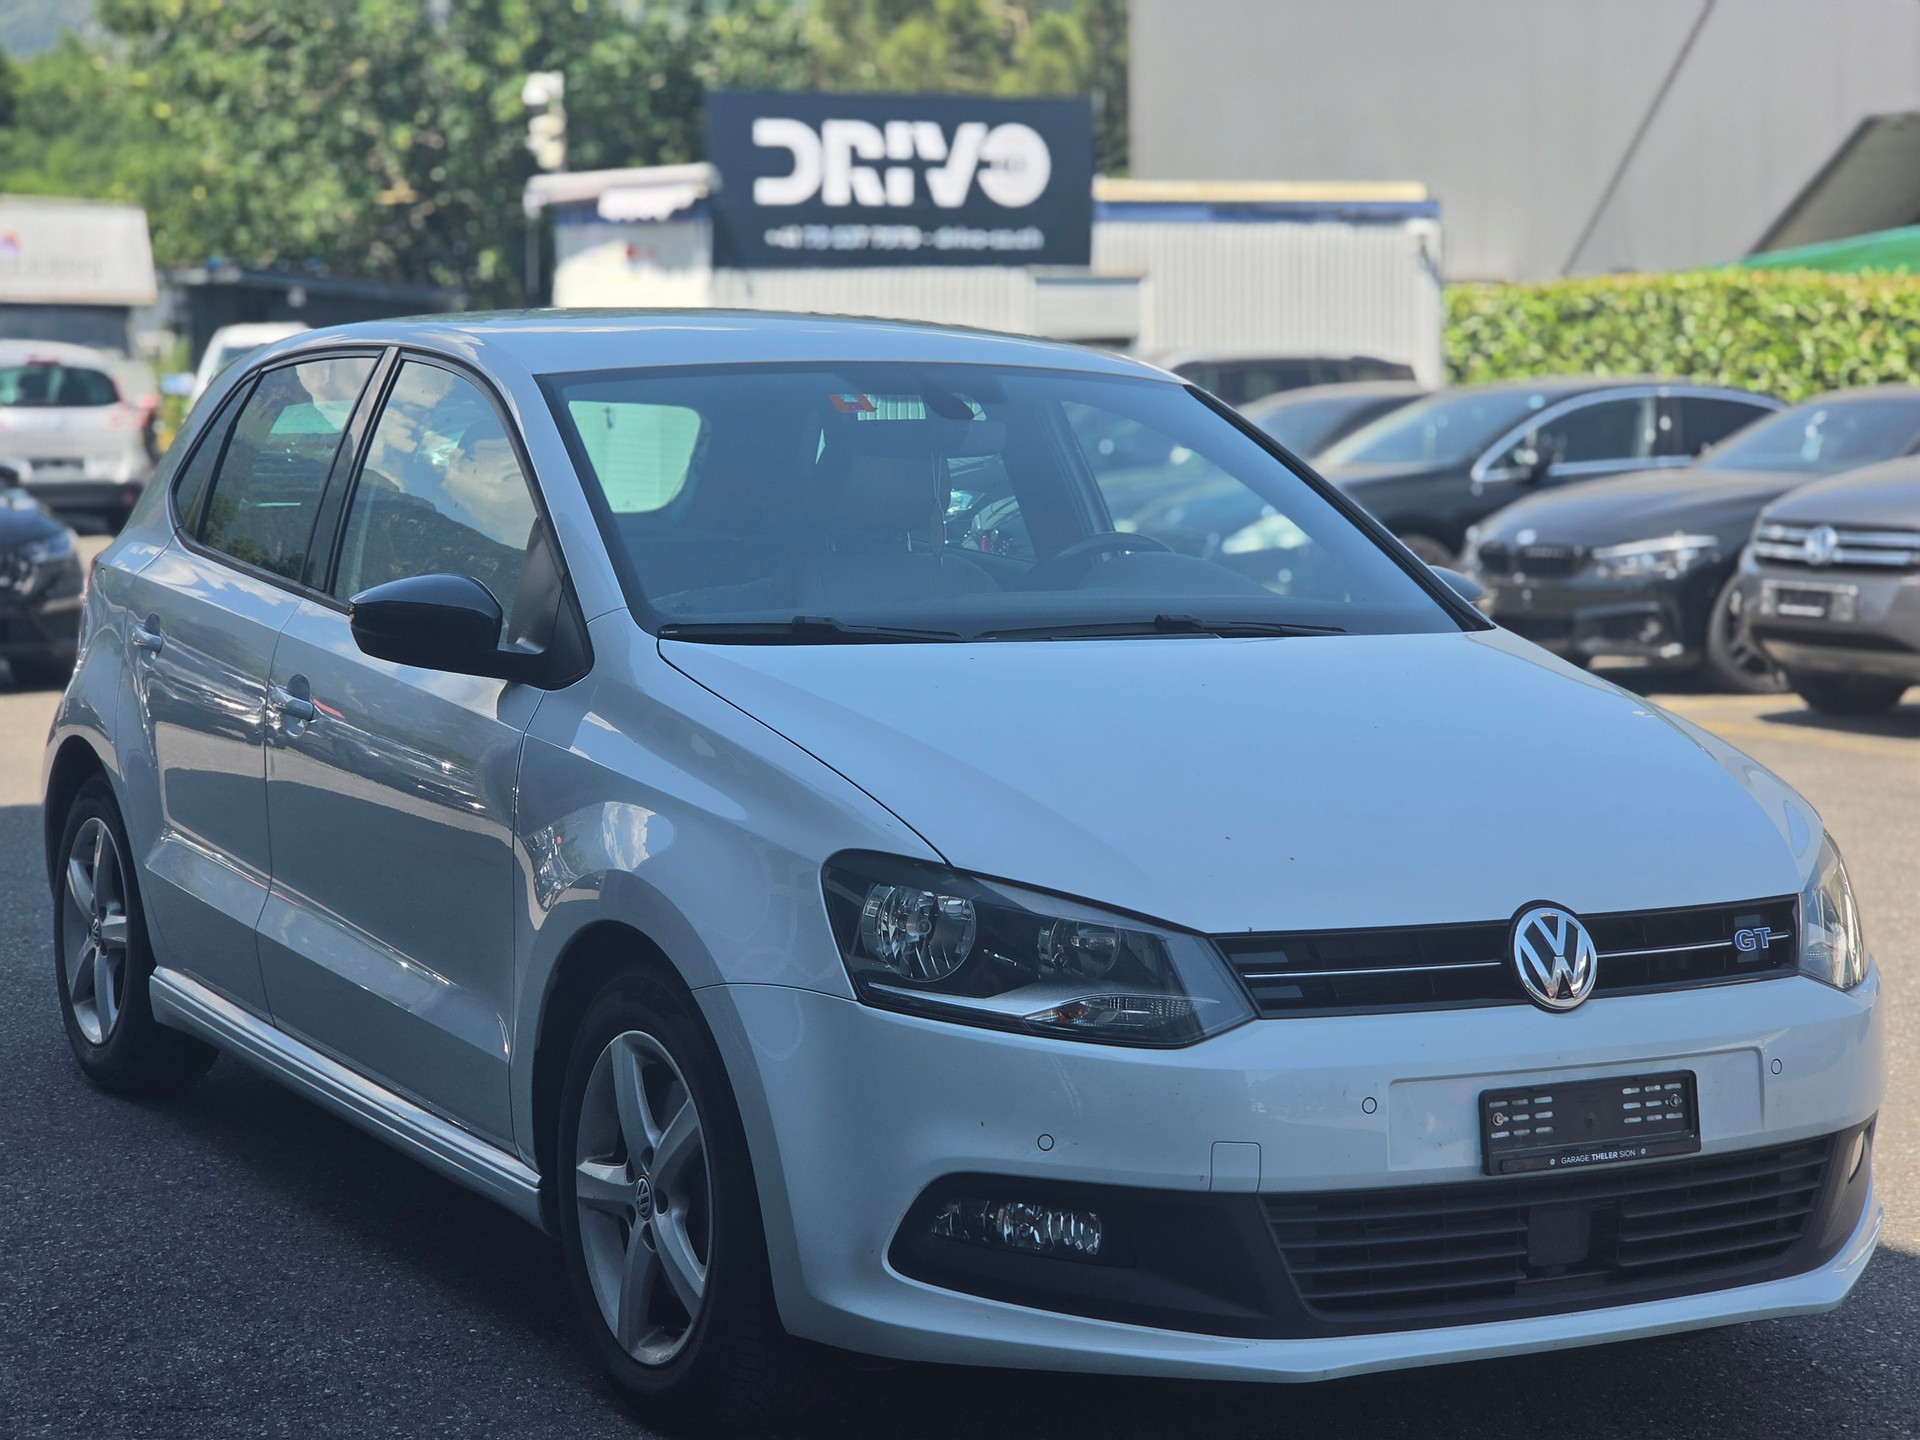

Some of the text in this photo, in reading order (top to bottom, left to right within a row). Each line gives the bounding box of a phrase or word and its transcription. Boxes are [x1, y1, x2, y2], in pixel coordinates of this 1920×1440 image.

[1734, 927, 1771, 951] GT
[1561, 1149, 1636, 1165] GARAGE THELER SION
